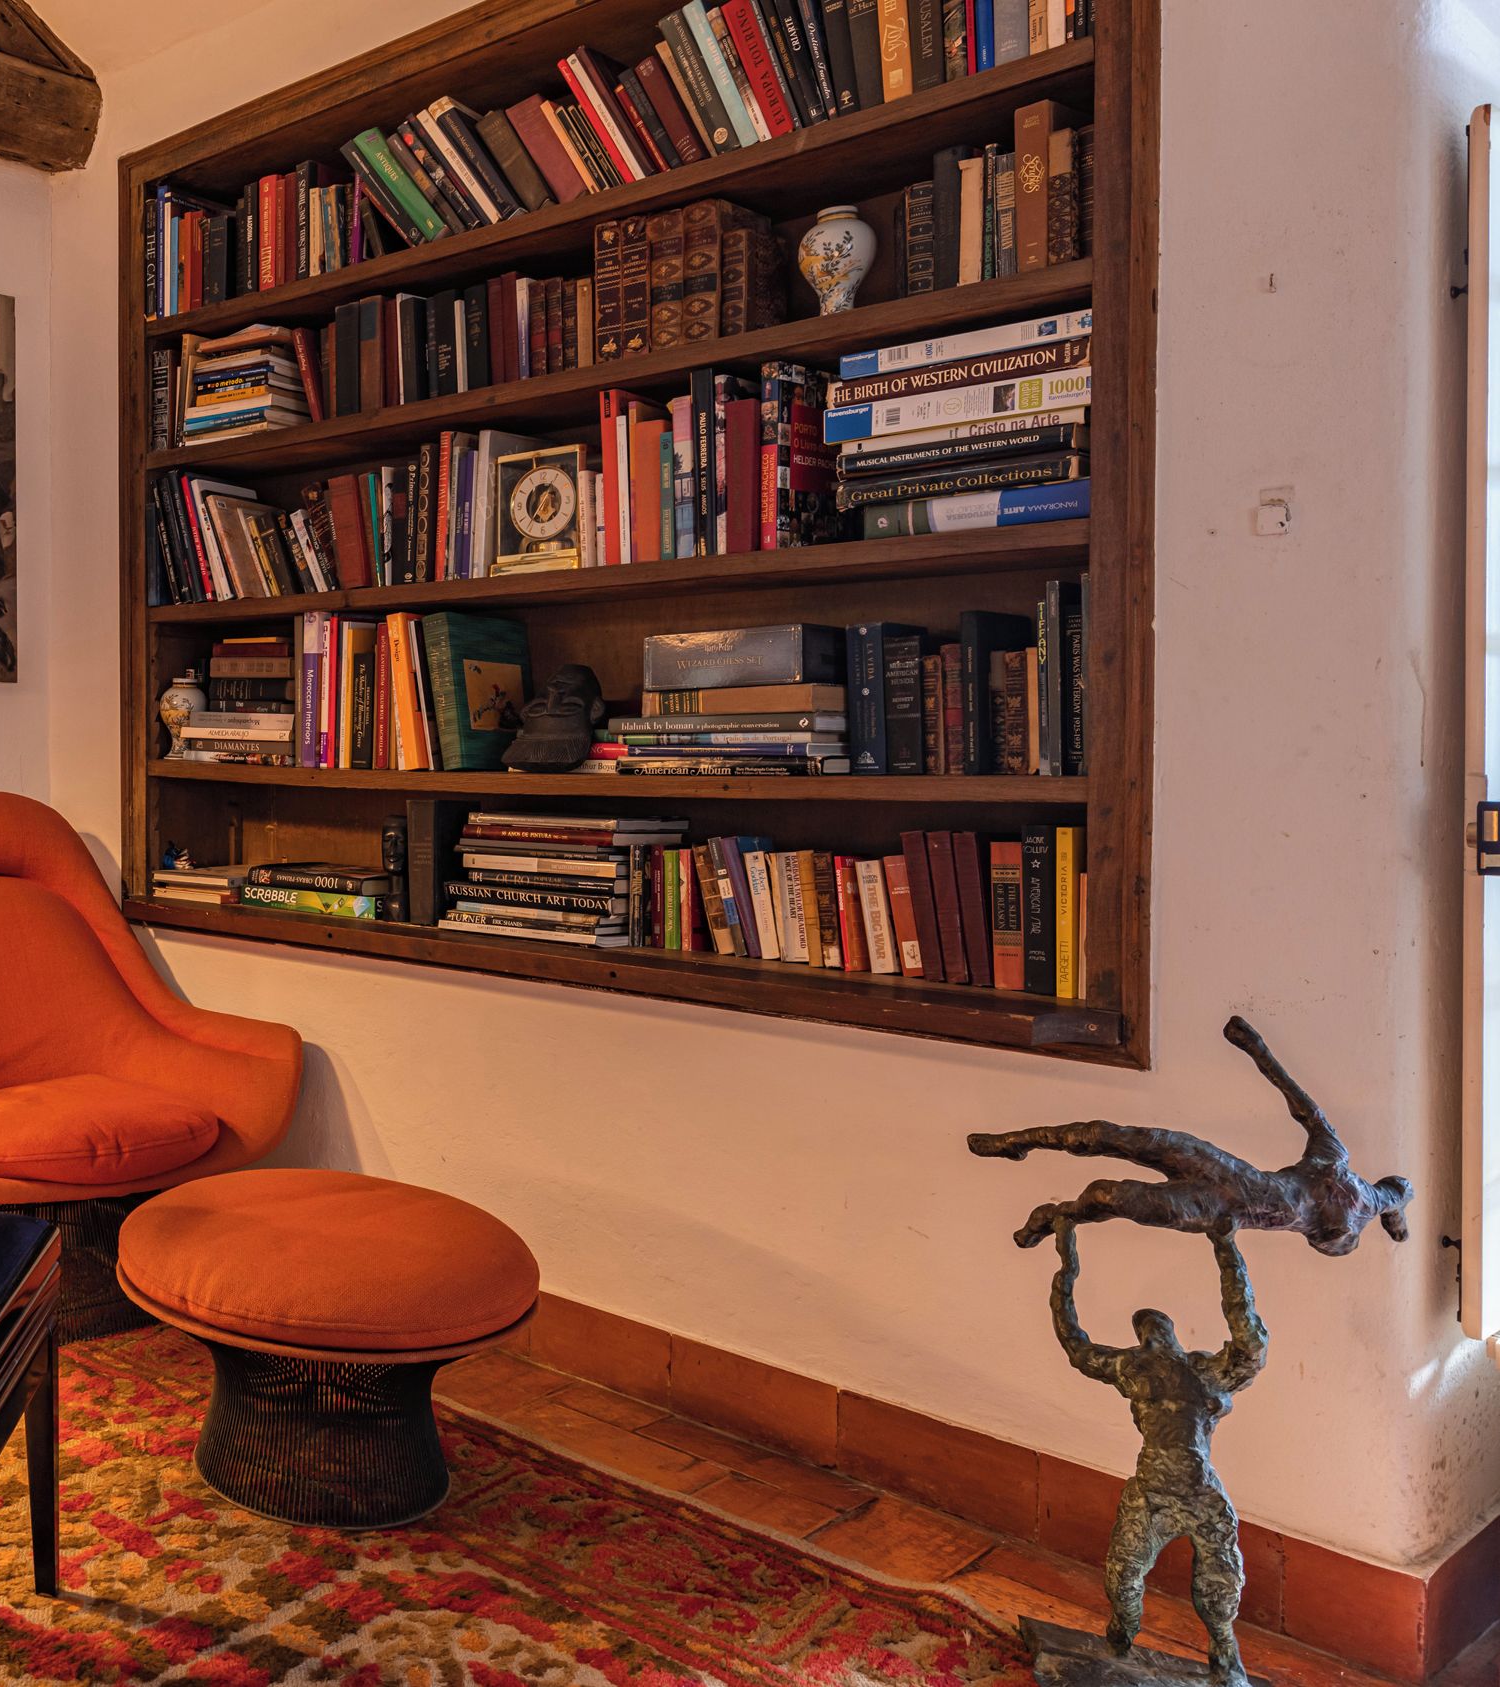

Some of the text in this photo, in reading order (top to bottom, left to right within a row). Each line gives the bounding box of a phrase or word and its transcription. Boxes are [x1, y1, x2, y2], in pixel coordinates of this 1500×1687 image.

[734, 7, 765, 68] TOURING
[783, 14, 802, 52] CRIARTE
[757, 69, 787, 126] EUROPA
[373, 149, 399, 183] ANTIQUES
[984, 203, 994, 222] VIDA
[982, 233, 993, 261] DEPOIS
[146, 232, 156, 288] THE CAT
[854, 381, 889, 400] BIRTH
[891, 377, 908, 392] OF
[910, 365, 968, 387] WESTERN
[970, 348, 1057, 378] CIVILIZATION
[1048, 375, 1085, 395] 1000
[698, 411, 706, 434] PAULO
[827, 405, 870, 418] Ravensburger
[969, 413, 1060, 437] Cristo na Arte
[698, 435, 707, 469] FERREIRA
[768, 452, 776, 469] NATAL
[793, 453, 818, 467] HELDER
[856, 434, 1040, 468] MUSICAL INSTRUMENTS OF THE WESTERN WORLD
[699, 476, 707, 491] SEUS
[768, 469, 775, 479] DO
[851, 466, 1053, 502] Great Private Collections
[407, 471, 416, 502] Princess
[761, 452, 769, 523] HELDER PACHECO
[565, 495, 571, 505] 3
[699, 493, 707, 516] AMIGOS
[1002, 505, 1026, 515] ARTE
[1026, 499, 1078, 512] PANORAMA
[539, 526, 546, 535] 6
[316, 551, 328, 574] HARLAN
[391, 638, 402, 662] Design
[1072, 633, 1081, 655] PARIS
[358, 662, 366, 674] The
[675, 654, 763, 670] WIZARD CHESS SET
[864, 642, 876, 680] LA VIDA
[1072, 654, 1081, 672] WAS
[885, 669, 919, 678] AMERICAN
[1072, 672, 1081, 713] YESTERDAY
[303, 668, 314, 745] Moroccan Interiors
[620, 722, 651, 730] blahnik
[652, 721, 662, 732] by
[664, 721, 694, 730] boman
[700, 722, 739, 730] photographic
[762, 734, 792, 742] Portugal
[213, 741, 260, 751] DIAMANTES
[633, 766, 731, 776] American Album
[275, 873, 339, 889] 1000 OBRAS-PRIMAS
[749, 865, 760, 895] Goddard
[757, 868, 767, 890] Robert
[783, 854, 796, 919] VOICE OF THE HEART
[242, 886, 298, 905] SCRABBLE
[447, 884, 610, 911] RUSSIAN CHURCH ART TODAY
[790, 854, 807, 949] BARBARA TAYLOR BRADFORD
[996, 883, 1006, 929] OF REASON
[1006, 885, 1016, 929] THE SLEEP
[1028, 876, 1041, 935] AMERICAN STAR
[449, 912, 487, 924] TURNER
[866, 885, 885, 960] THE BIG WAR
[1058, 939, 1069, 984] TARGETTI
